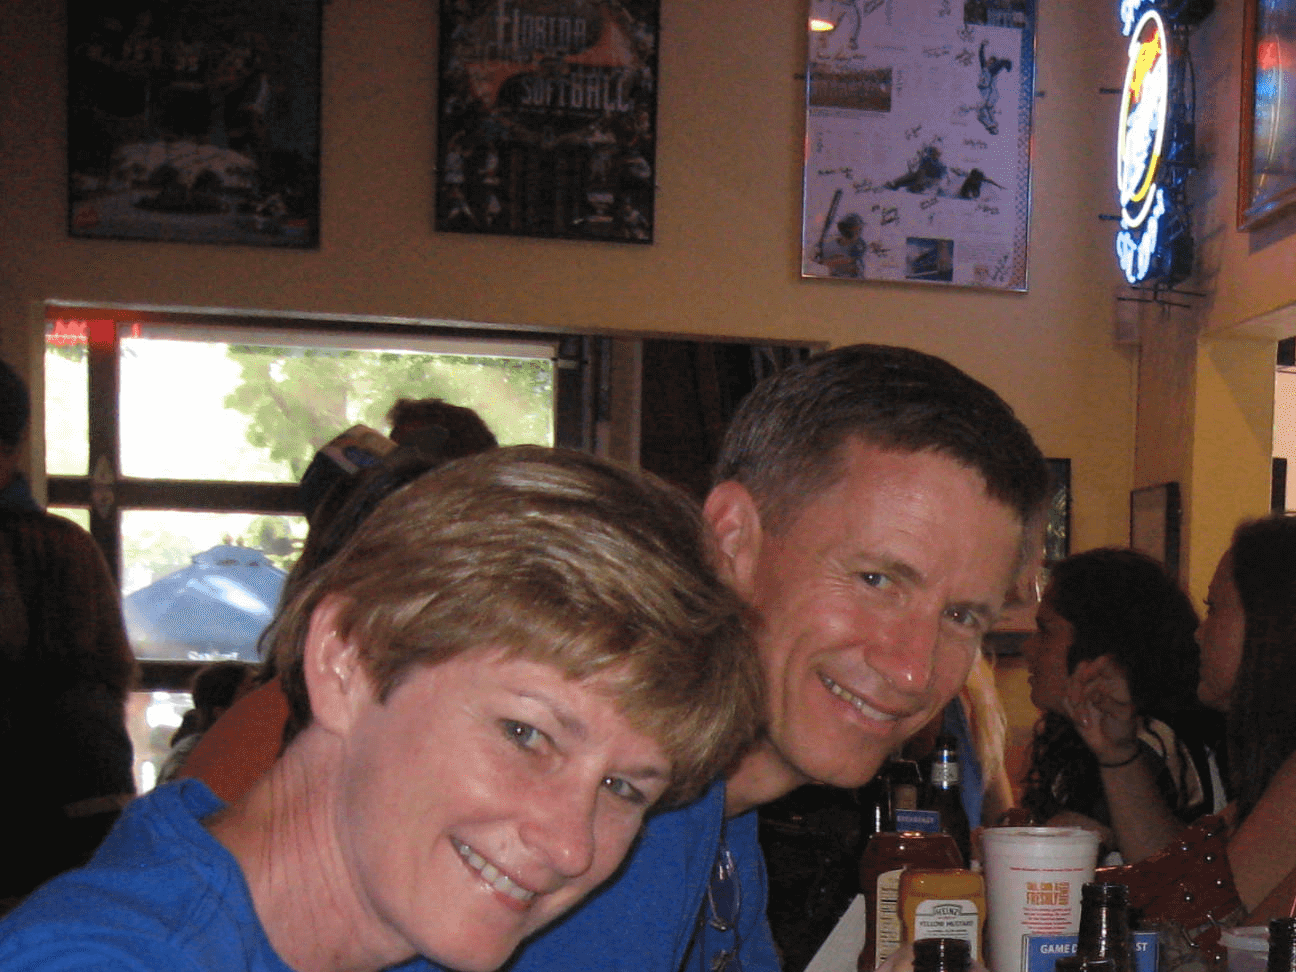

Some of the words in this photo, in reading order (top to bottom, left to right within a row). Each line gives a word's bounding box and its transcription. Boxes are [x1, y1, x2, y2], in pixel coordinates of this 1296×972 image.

[521, 66, 632, 112] SOFTBALL
[935, 907, 959, 916] HEINZ
[1040, 943, 1070, 954] GAME
